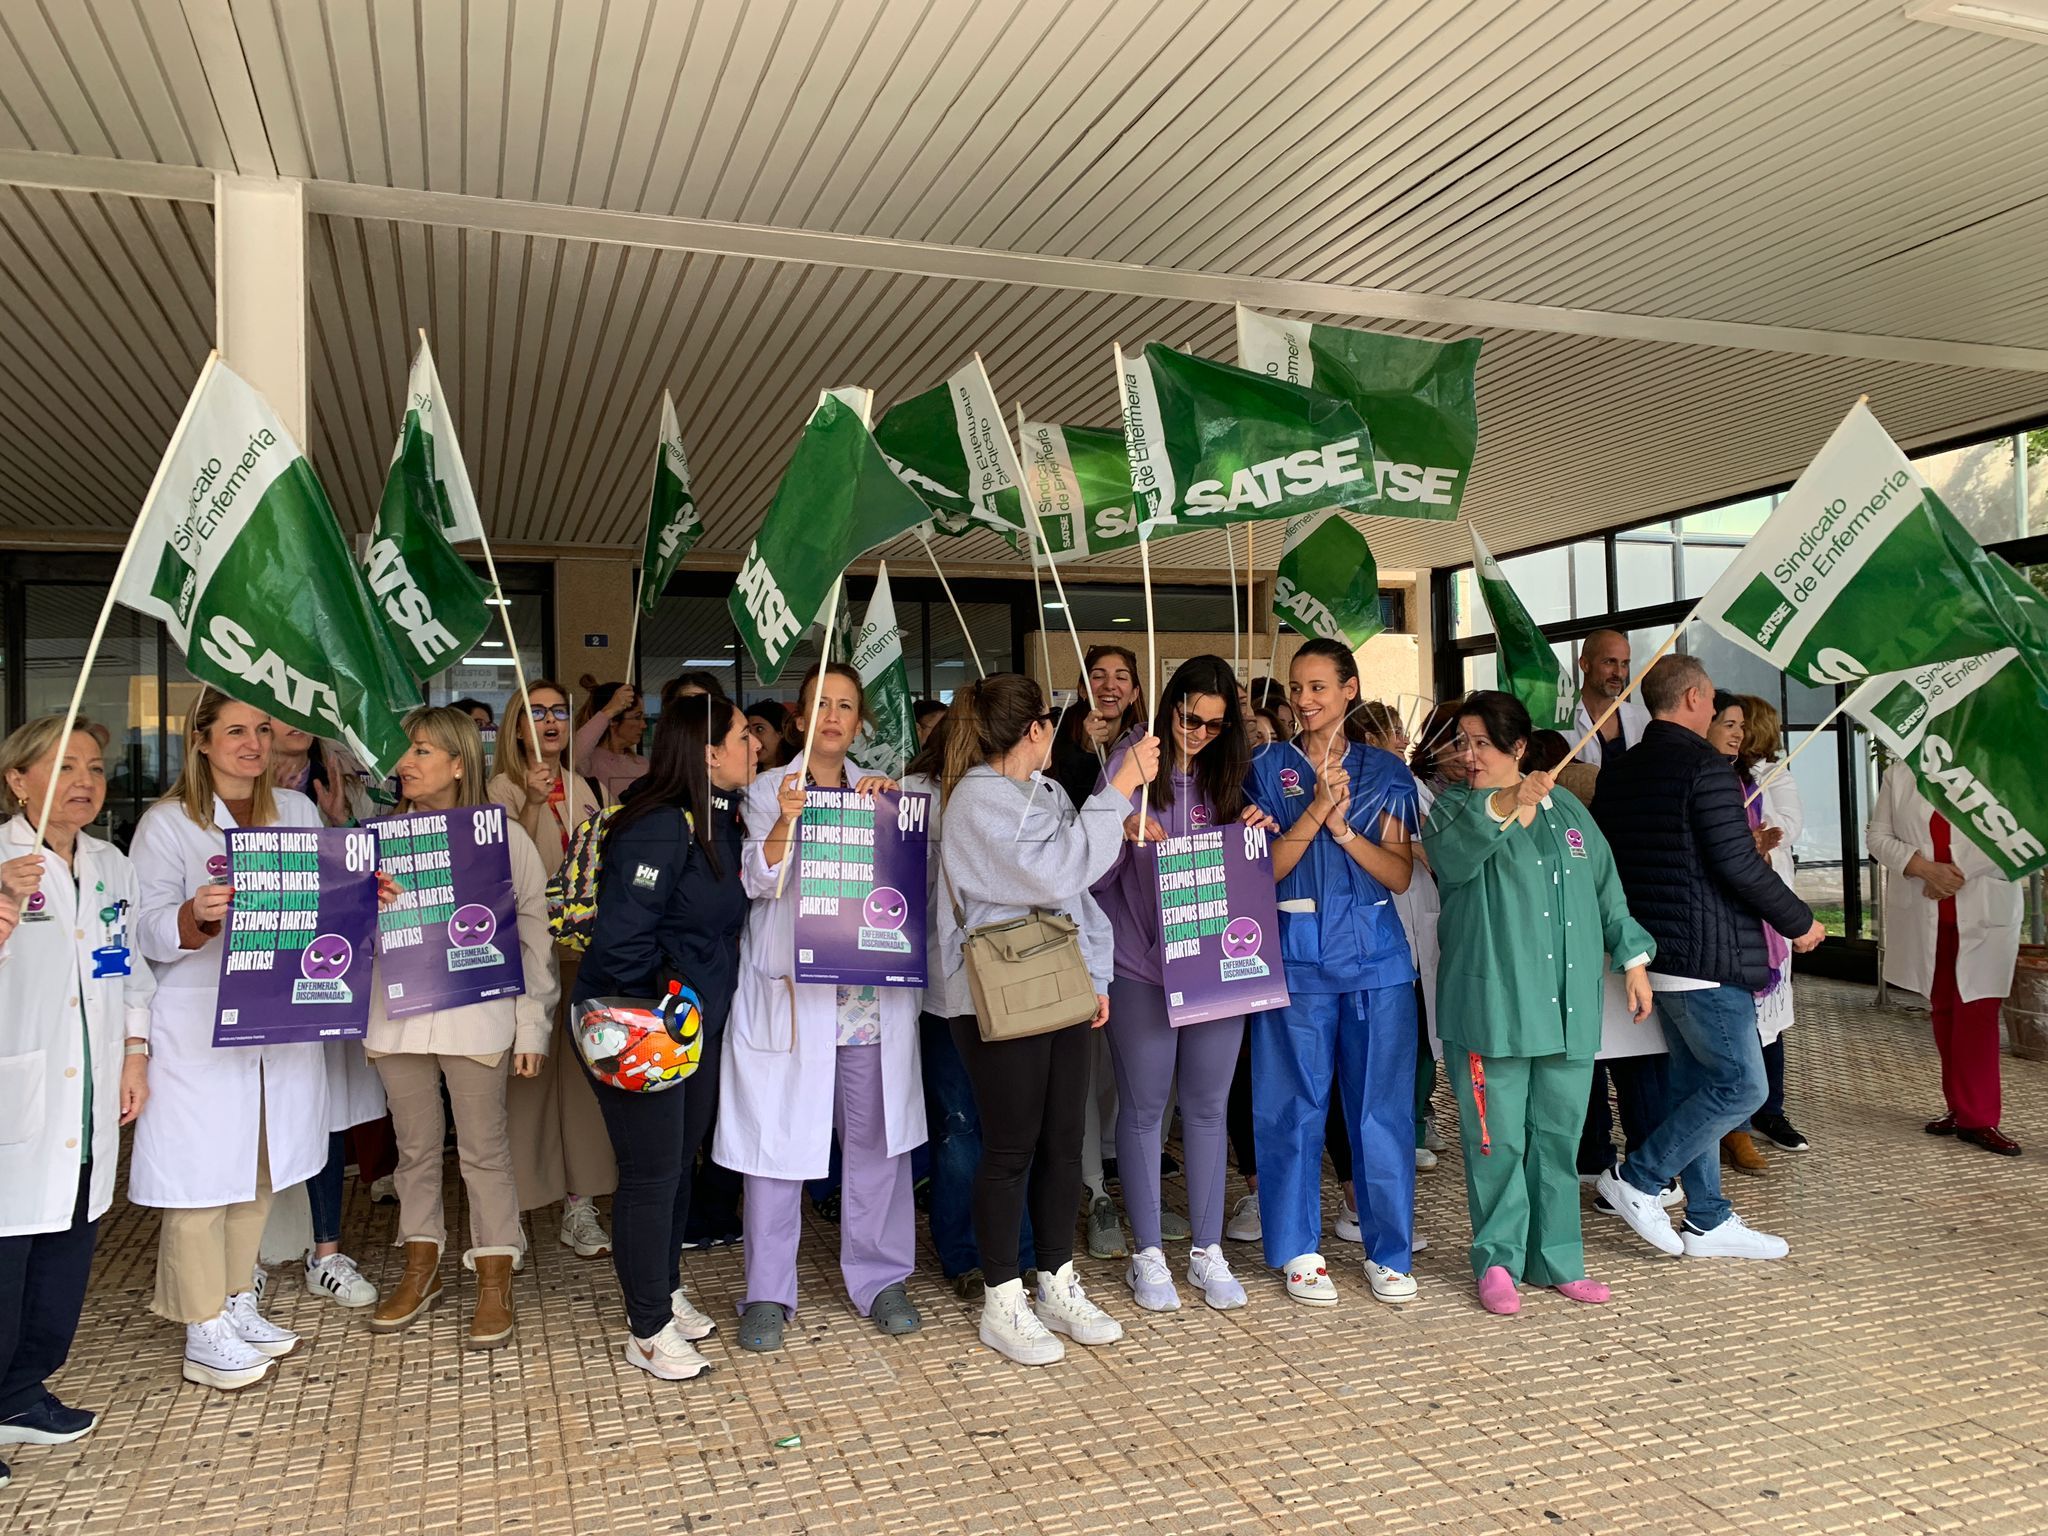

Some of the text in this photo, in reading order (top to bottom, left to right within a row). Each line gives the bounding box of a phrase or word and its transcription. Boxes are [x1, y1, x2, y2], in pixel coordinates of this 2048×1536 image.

[1125, 373, 1149, 462] Enfermería
[196, 428, 277, 541] Enfermería
[1138, 465, 1155, 487] de
[1184, 437, 1364, 516] SATSE
[1374, 460, 1460, 505] TSE
[1056, 492, 1070, 511] de
[1060, 515, 1071, 548] SATSE
[1774, 498, 1847, 585] Sindicato
[1793, 575, 1818, 603] de
[1812, 470, 1911, 578] Enfermería
[363, 512, 461, 666] ATSE
[1756, 601, 1792, 646] SATSE
[592, 636, 600, 646] 2
[1896, 702, 1928, 734] SATSE
[711, 795, 729, 811] HH
[1920, 734, 2047, 868] SATSE
[801, 808, 875, 828] ESTAMOS HARTAS
[897, 796, 926, 832] 8M
[366, 815, 448, 840] TAMOS HARTAS
[472, 808, 504, 846] 8M
[801, 825, 875, 846] ESTAMOS HARTAS
[231, 832, 318, 852] ESTAMOS HARTAS
[379, 832, 449, 858] TAMOS HARTAS
[1193, 830, 1223, 852] HARTAS
[1243, 826, 1268, 860] 8M
[233, 852, 319, 871] ESTAMOS HARTAS
[345, 833, 375, 872] 8M
[414, 850, 451, 872] HARTAS
[801, 842, 874, 863] ESTAMOS HARTAS
[1158, 848, 1224, 874] ESTAMOS HARTAS
[233, 871, 280, 891] ESTAMOS
[282, 871, 320, 891] HARTAS
[416, 868, 453, 889] HARTAS
[636, 864, 659, 881] HH
[800, 860, 874, 881] ESTAMOS HARTAS
[1159, 865, 1226, 892] ESTAMOS HARTAS
[418, 885, 455, 907] HARTAS
[800, 879, 840, 897] ESTAMOS
[1161, 882, 1227, 909] ESTAMOS HARTAS
[233, 891, 320, 911] ESTAMOS HARTAS
[799, 897, 839, 918] ¡HARTAS!
[232, 910, 318, 931] ESTAMOS HARTAS
[378, 909, 420, 932] ESTAMOS
[1162, 899, 1228, 926] ESTAMOS HARTAS
[230, 931, 276, 951] ESTAMOS
[381, 926, 423, 954] ¡HARTAS!
[861, 930, 898, 940] ENFERMERAS
[1163, 921, 1199, 943] ESTAMOS
[450, 946, 489, 960] ENFERMERAS
[861, 940, 905, 950] DISCRIMINADAS
[1165, 938, 1200, 964] ¡HARTAS!
[226, 950, 274, 975] ¡HARTAS!
[451, 954, 498, 968] DISCRIMINADAS
[1222, 958, 1256, 970] ENFERMERAS
[1223, 966, 1264, 978] DISCRIMINADAS
[295, 991, 345, 1000] DISCRIMINADAS
[296, 981, 339, 991] ENFERMERAS
